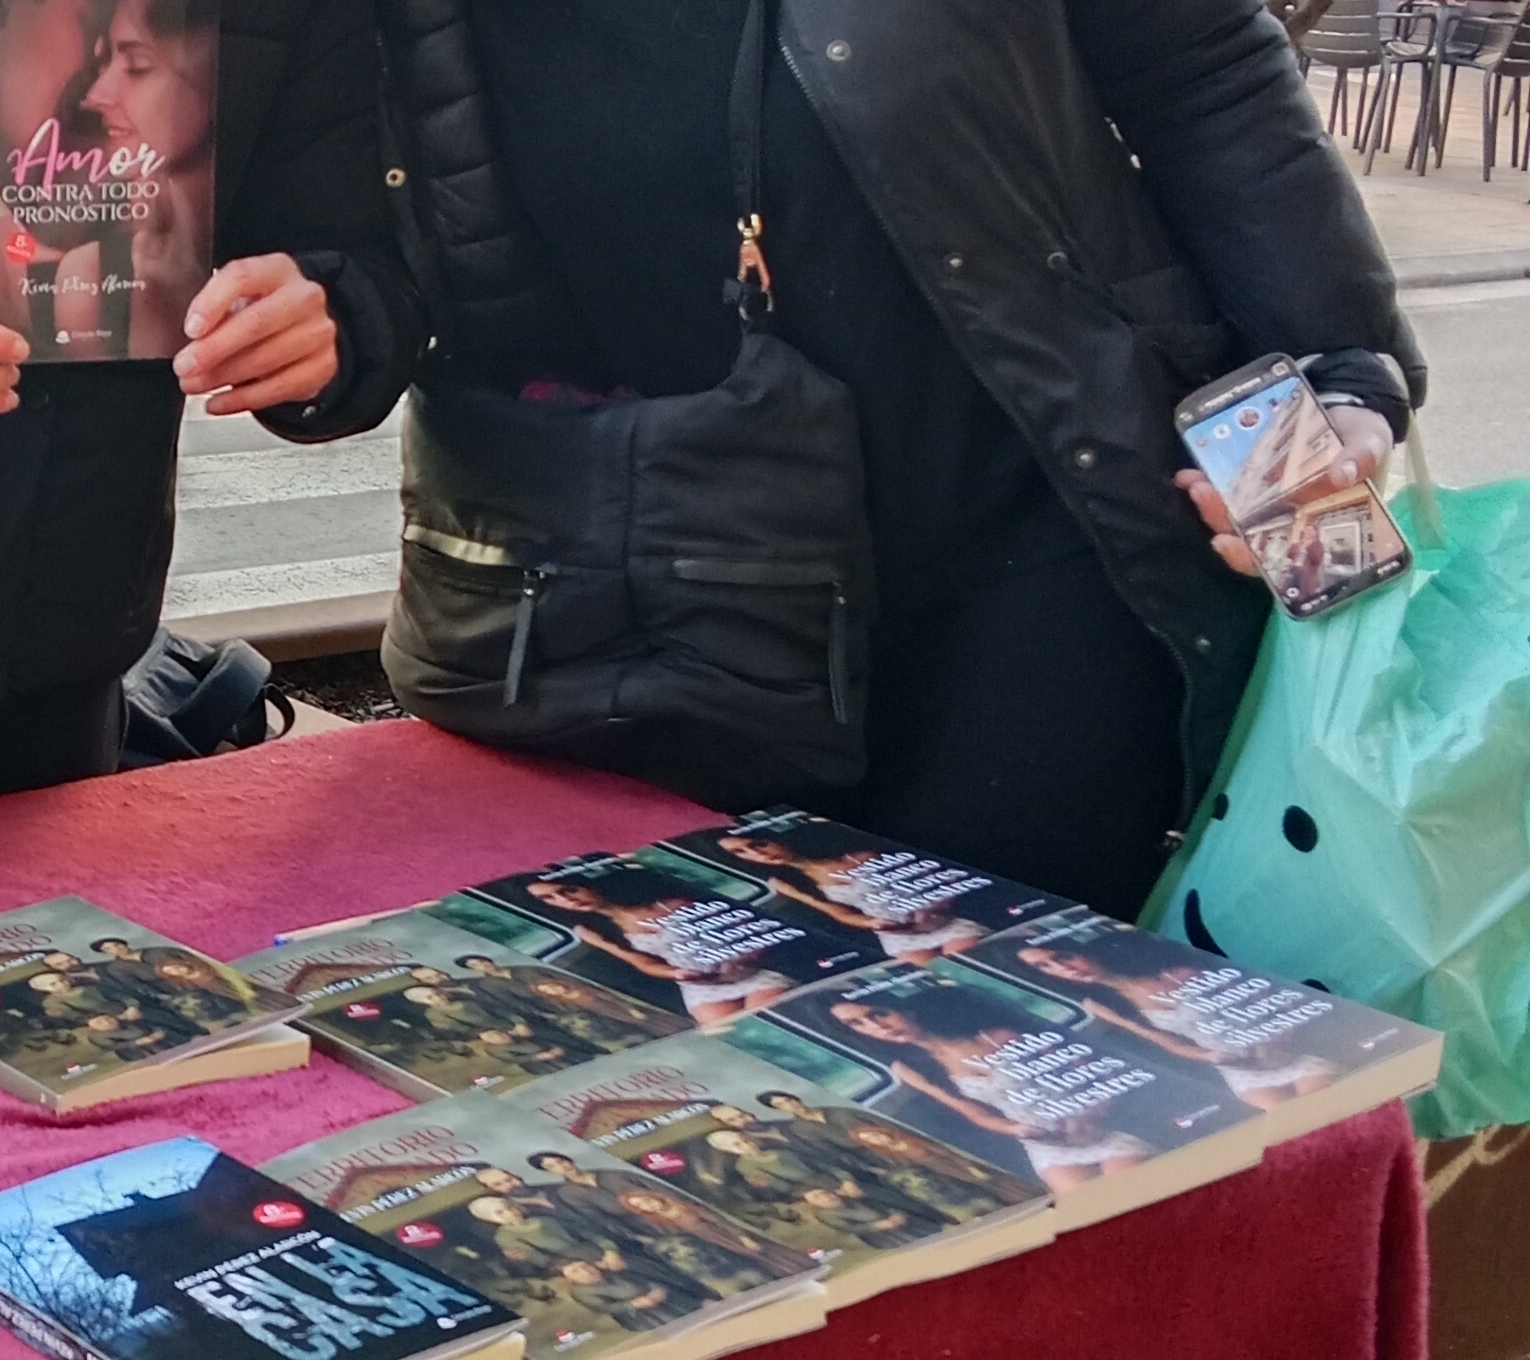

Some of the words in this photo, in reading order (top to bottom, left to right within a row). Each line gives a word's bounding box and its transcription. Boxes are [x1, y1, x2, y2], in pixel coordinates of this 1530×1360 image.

[6, 118, 166, 189] Amor
[2, 183, 93, 204] CONTRA
[98, 181, 160, 201] TODO
[13, 201, 150, 224] PRONÓSTICO
[828, 850, 917, 880] Vestido
[859, 858, 942, 889] blanco
[864, 889, 893, 906] de
[889, 868, 969, 897] flores
[886, 876, 995, 915] silvestres
[636, 900, 731, 929] Vestido
[666, 908, 755, 936] blanco
[672, 940, 701, 955] de
[699, 917, 782, 946] flores
[693, 928, 807, 966] silvestres
[1149, 967, 1242, 1005] Vestido
[1183, 976, 1272, 1015] blanco
[1196, 1018, 1225, 1036] de
[1222, 987, 1305, 1027] flores
[1222, 999, 1334, 1049] silvestres
[961, 1029, 1065, 1070] Vestido
[1001, 1041, 1093, 1081] blanco
[535, 1065, 686, 1120] ERRITORIO
[1006, 1085, 1036, 1106] de
[1033, 1053, 1126, 1093] flores
[1035, 1066, 1157, 1121] silvestres
[286, 1124, 456, 1191] ERRITORIO
[186, 1266, 292, 1321] EN
